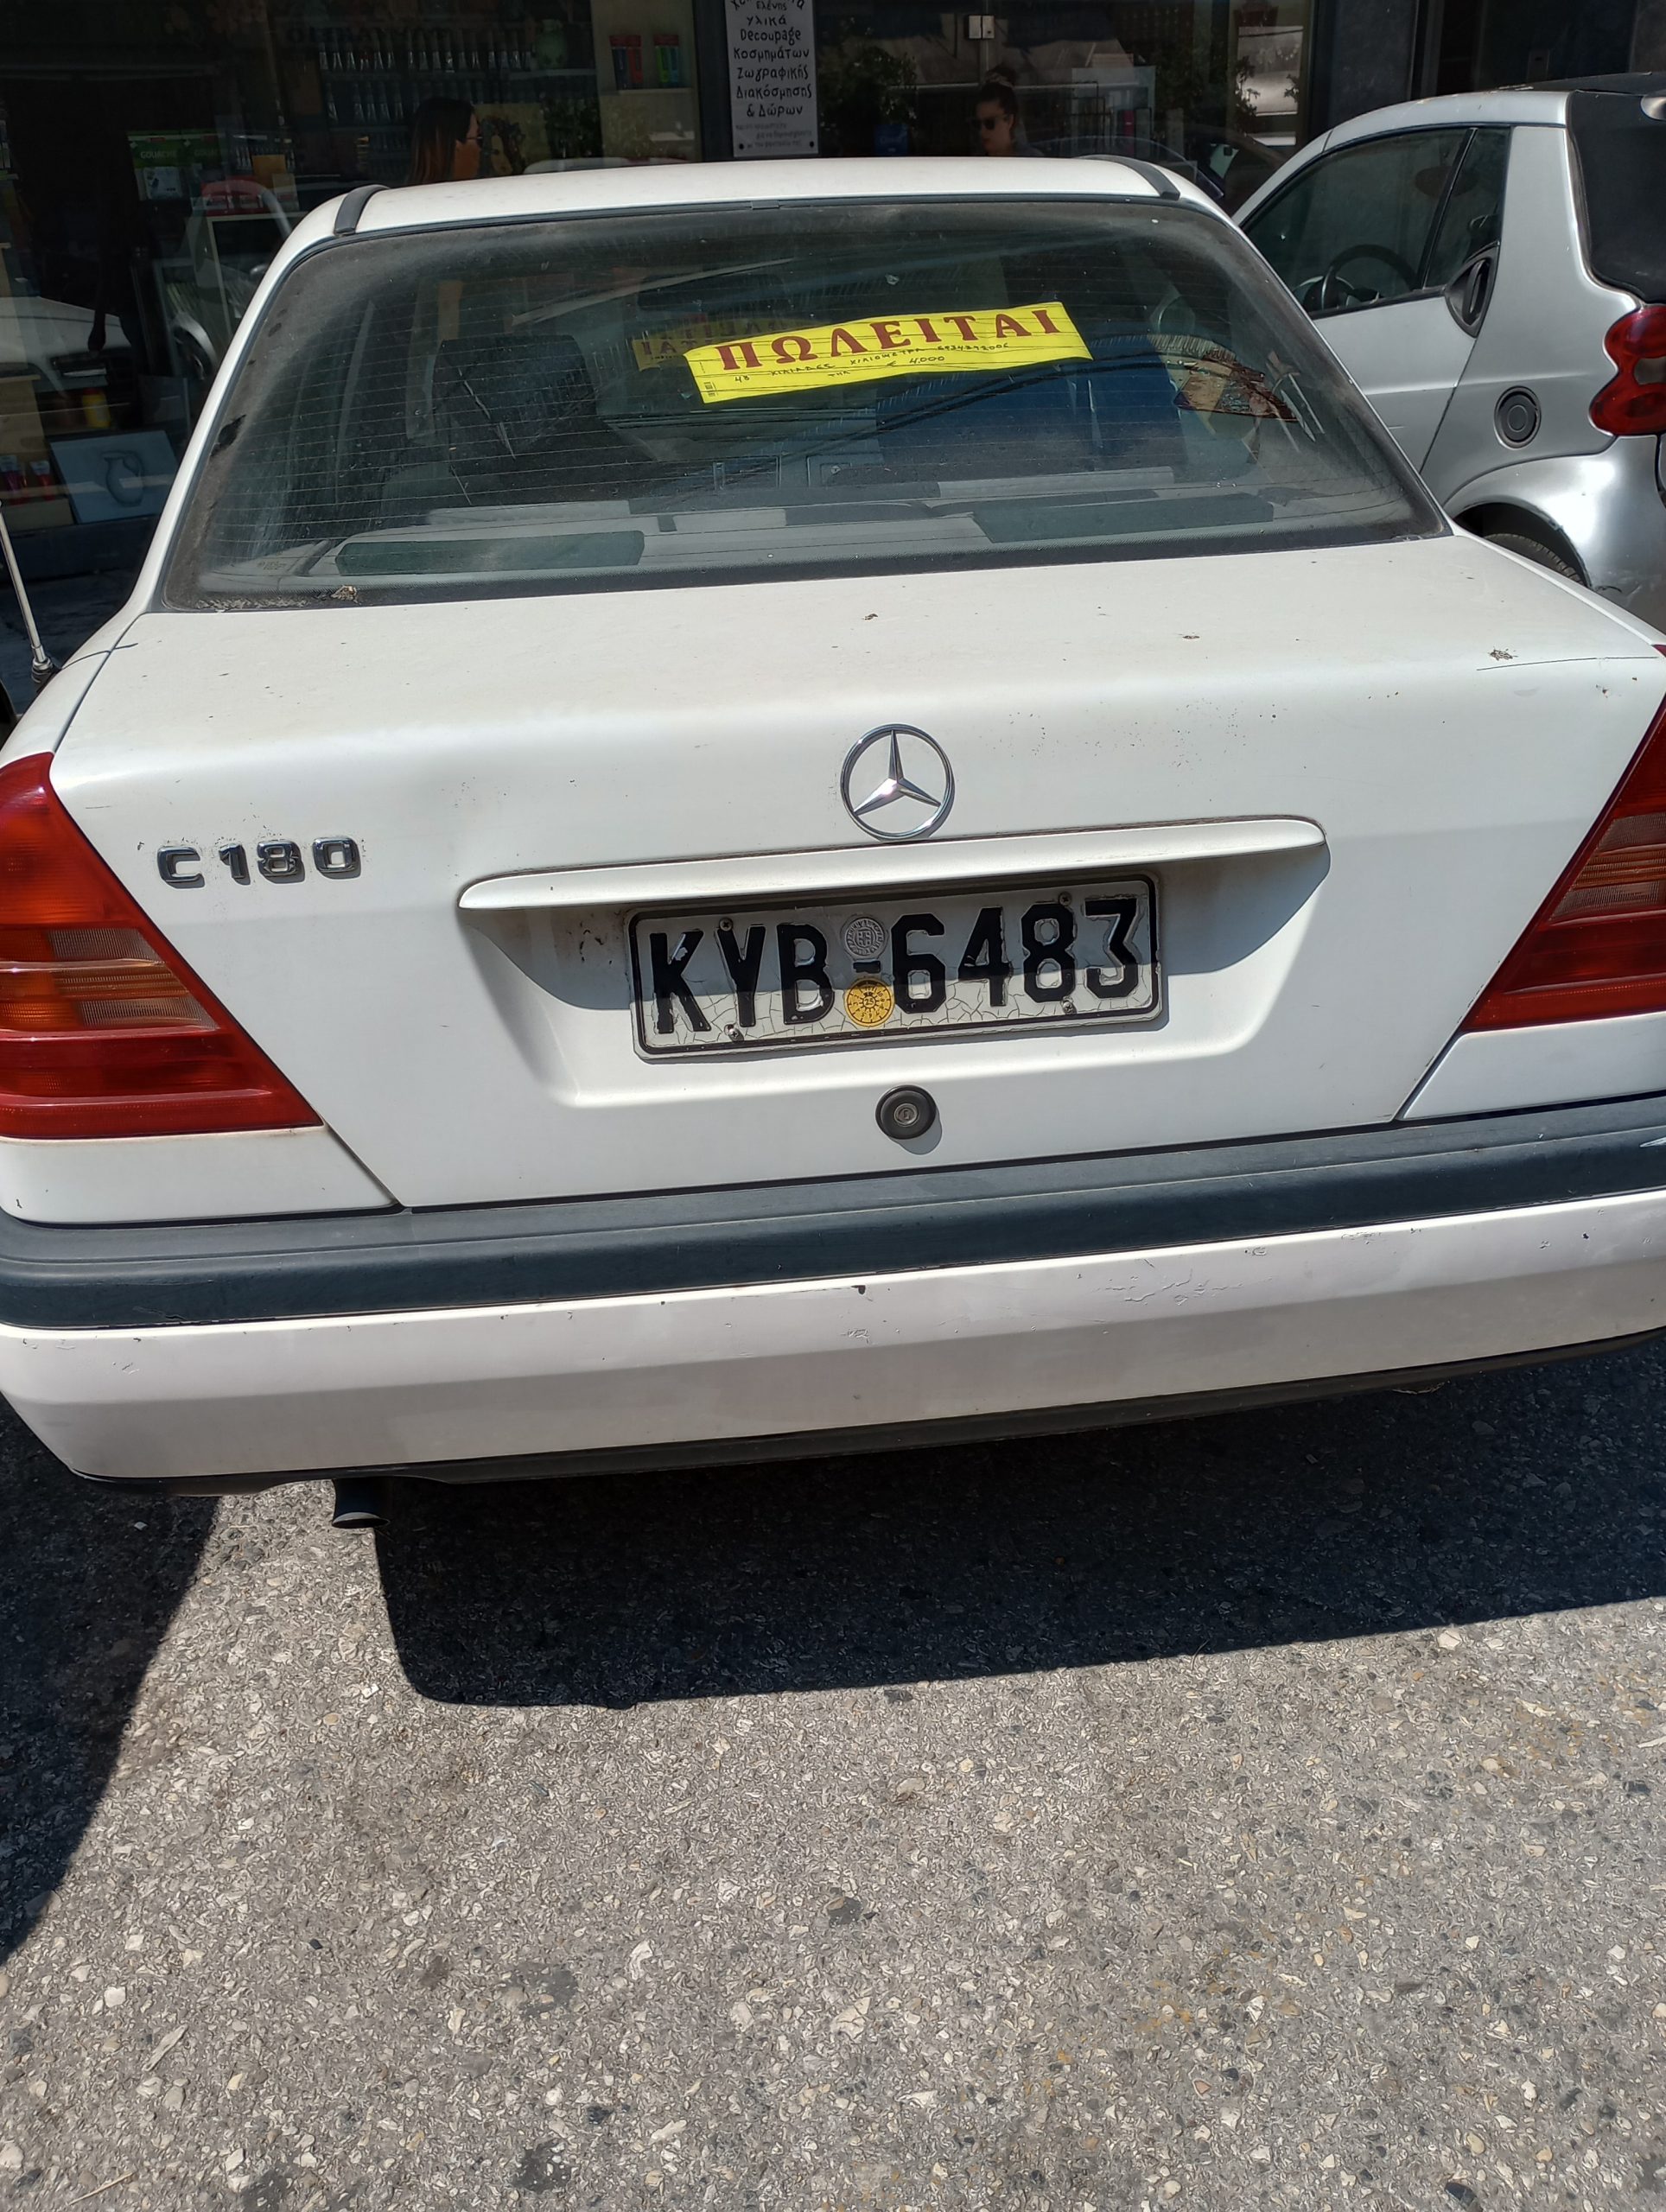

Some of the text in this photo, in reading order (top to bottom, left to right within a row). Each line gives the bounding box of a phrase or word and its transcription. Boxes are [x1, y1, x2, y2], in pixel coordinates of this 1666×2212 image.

[741, 28, 801, 45] Decoupage
[734, 47, 810, 62] Κοσμημάτων
[737, 65, 809, 82] Ζωγραφικής
[736, 84, 812, 100] Διακόσμησης
[747, 103, 803, 118] & Δώρων
[715, 309, 1061, 371] ΠΩΛΕΙΤΑΙ
